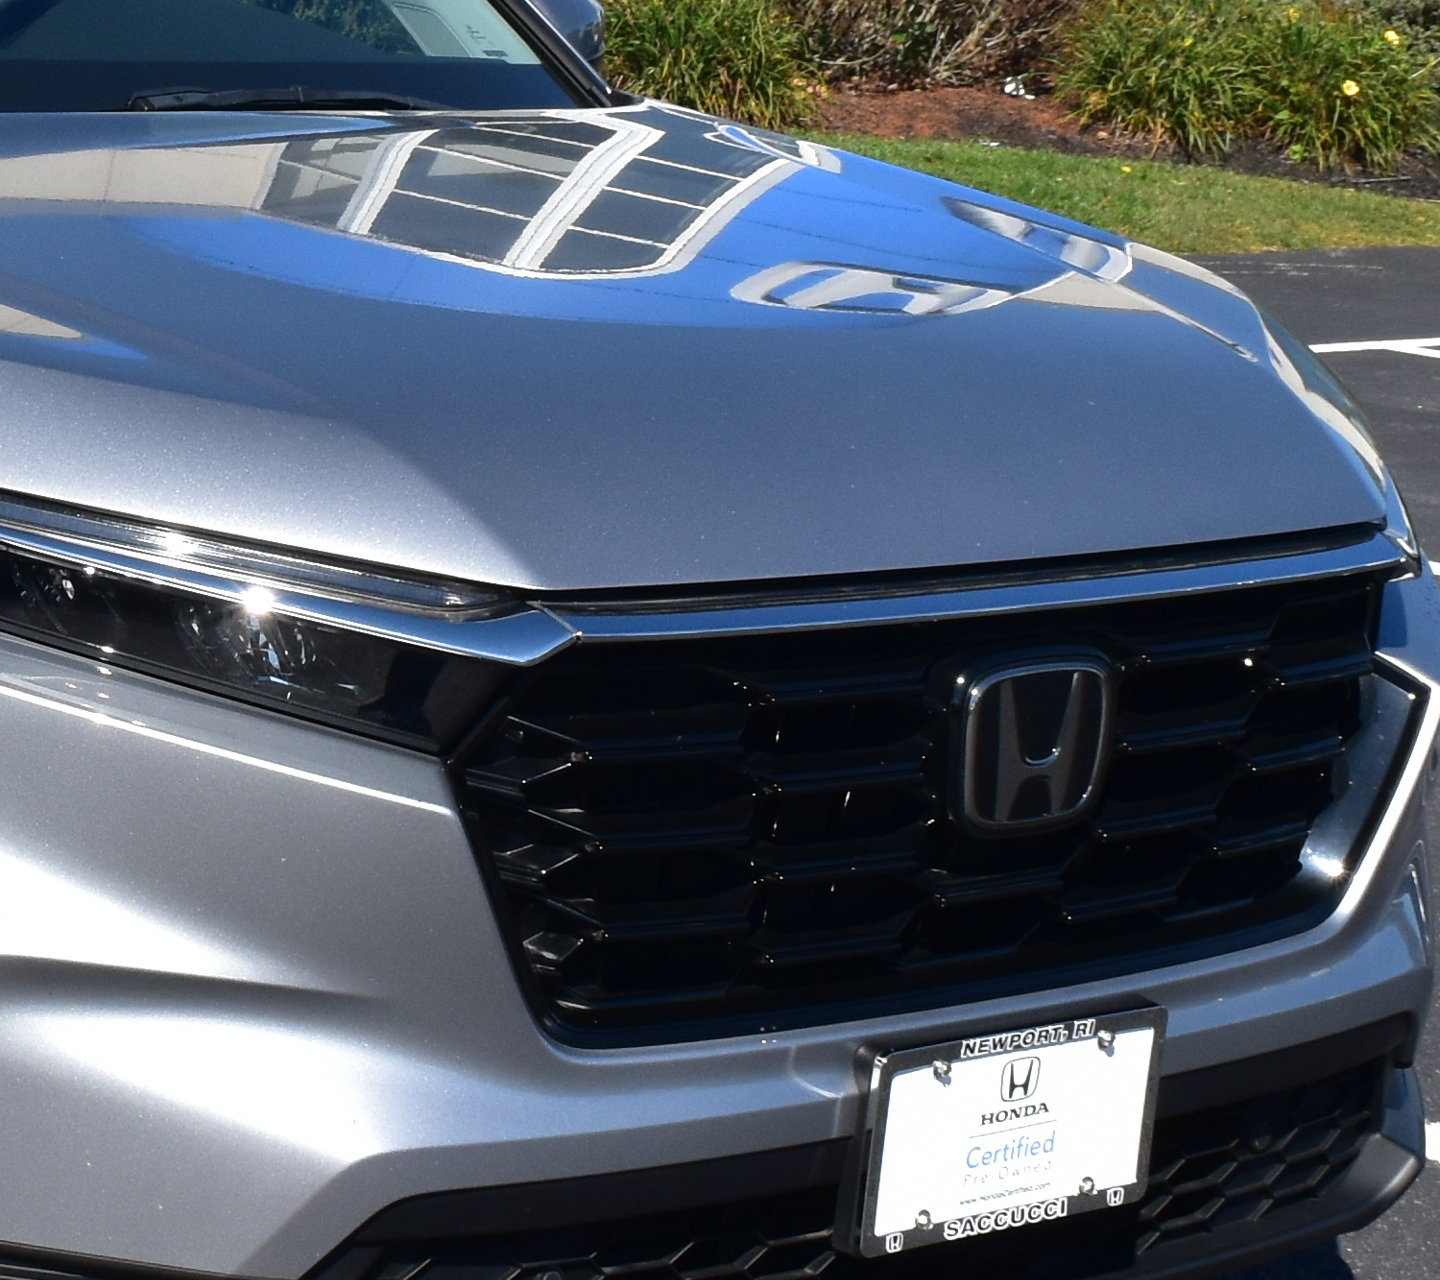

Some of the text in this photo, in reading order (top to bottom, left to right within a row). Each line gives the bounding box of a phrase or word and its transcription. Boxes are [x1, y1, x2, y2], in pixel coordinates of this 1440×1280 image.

[961, 1019, 1096, 1058] NEWPORT, RI
[980, 1102, 1049, 1126] HONDA
[966, 1130, 1056, 1169] Certified
[944, 1197, 1068, 1240] SACCUCCI
